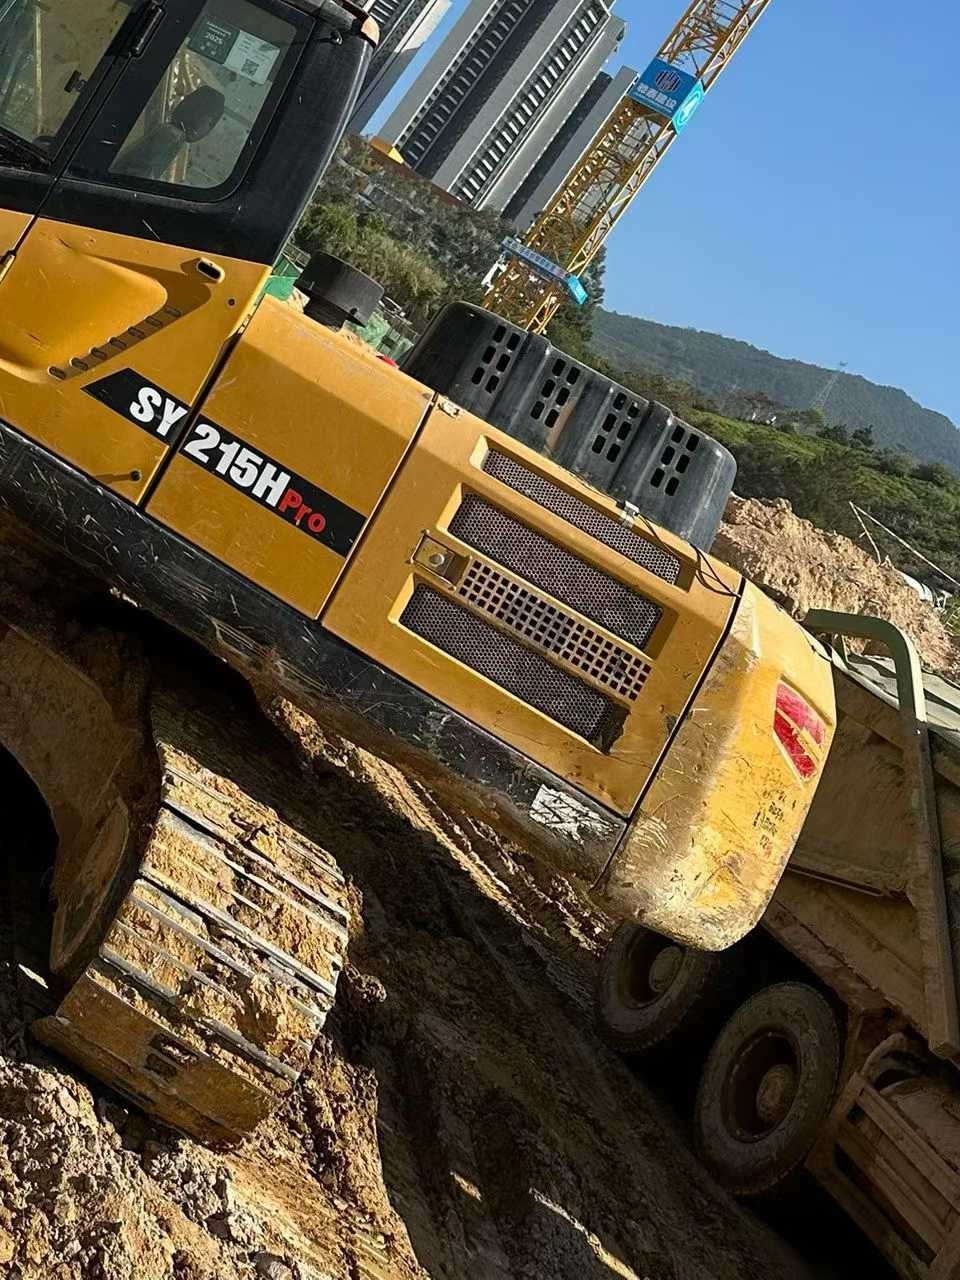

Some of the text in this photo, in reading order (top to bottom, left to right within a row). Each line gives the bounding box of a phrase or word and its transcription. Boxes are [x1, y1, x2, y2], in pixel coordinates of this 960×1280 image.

[129, 387, 326, 533] SY 215H Pro
